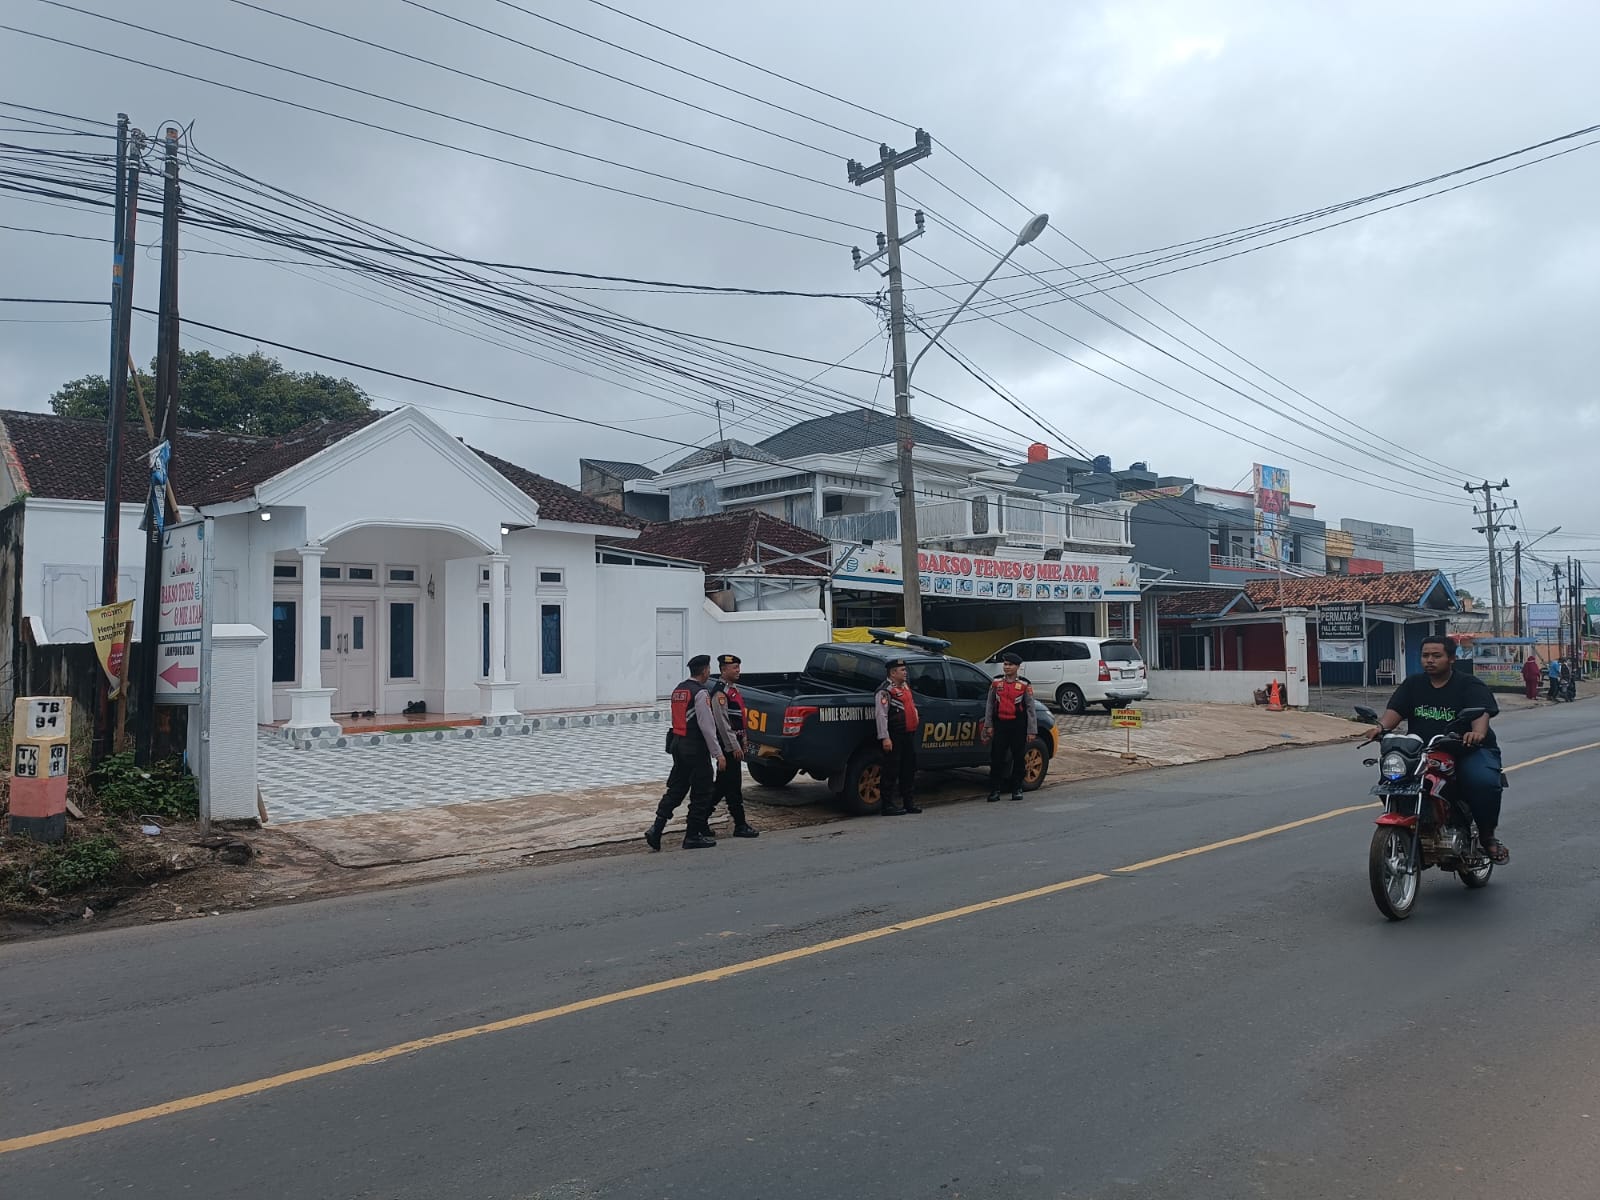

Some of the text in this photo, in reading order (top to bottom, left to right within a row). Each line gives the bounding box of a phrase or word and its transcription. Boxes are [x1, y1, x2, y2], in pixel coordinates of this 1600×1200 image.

[918, 552, 1099, 583] BAKSO TENES & MIE AYAM
[1321, 611, 1352, 622] PERMATA
[37, 702, 60, 713] TB
[819, 707, 839, 722] MOBILE
[840, 706, 863, 721] SECURITY
[922, 721, 977, 743] POLISI
[18, 748, 37, 761] TK
